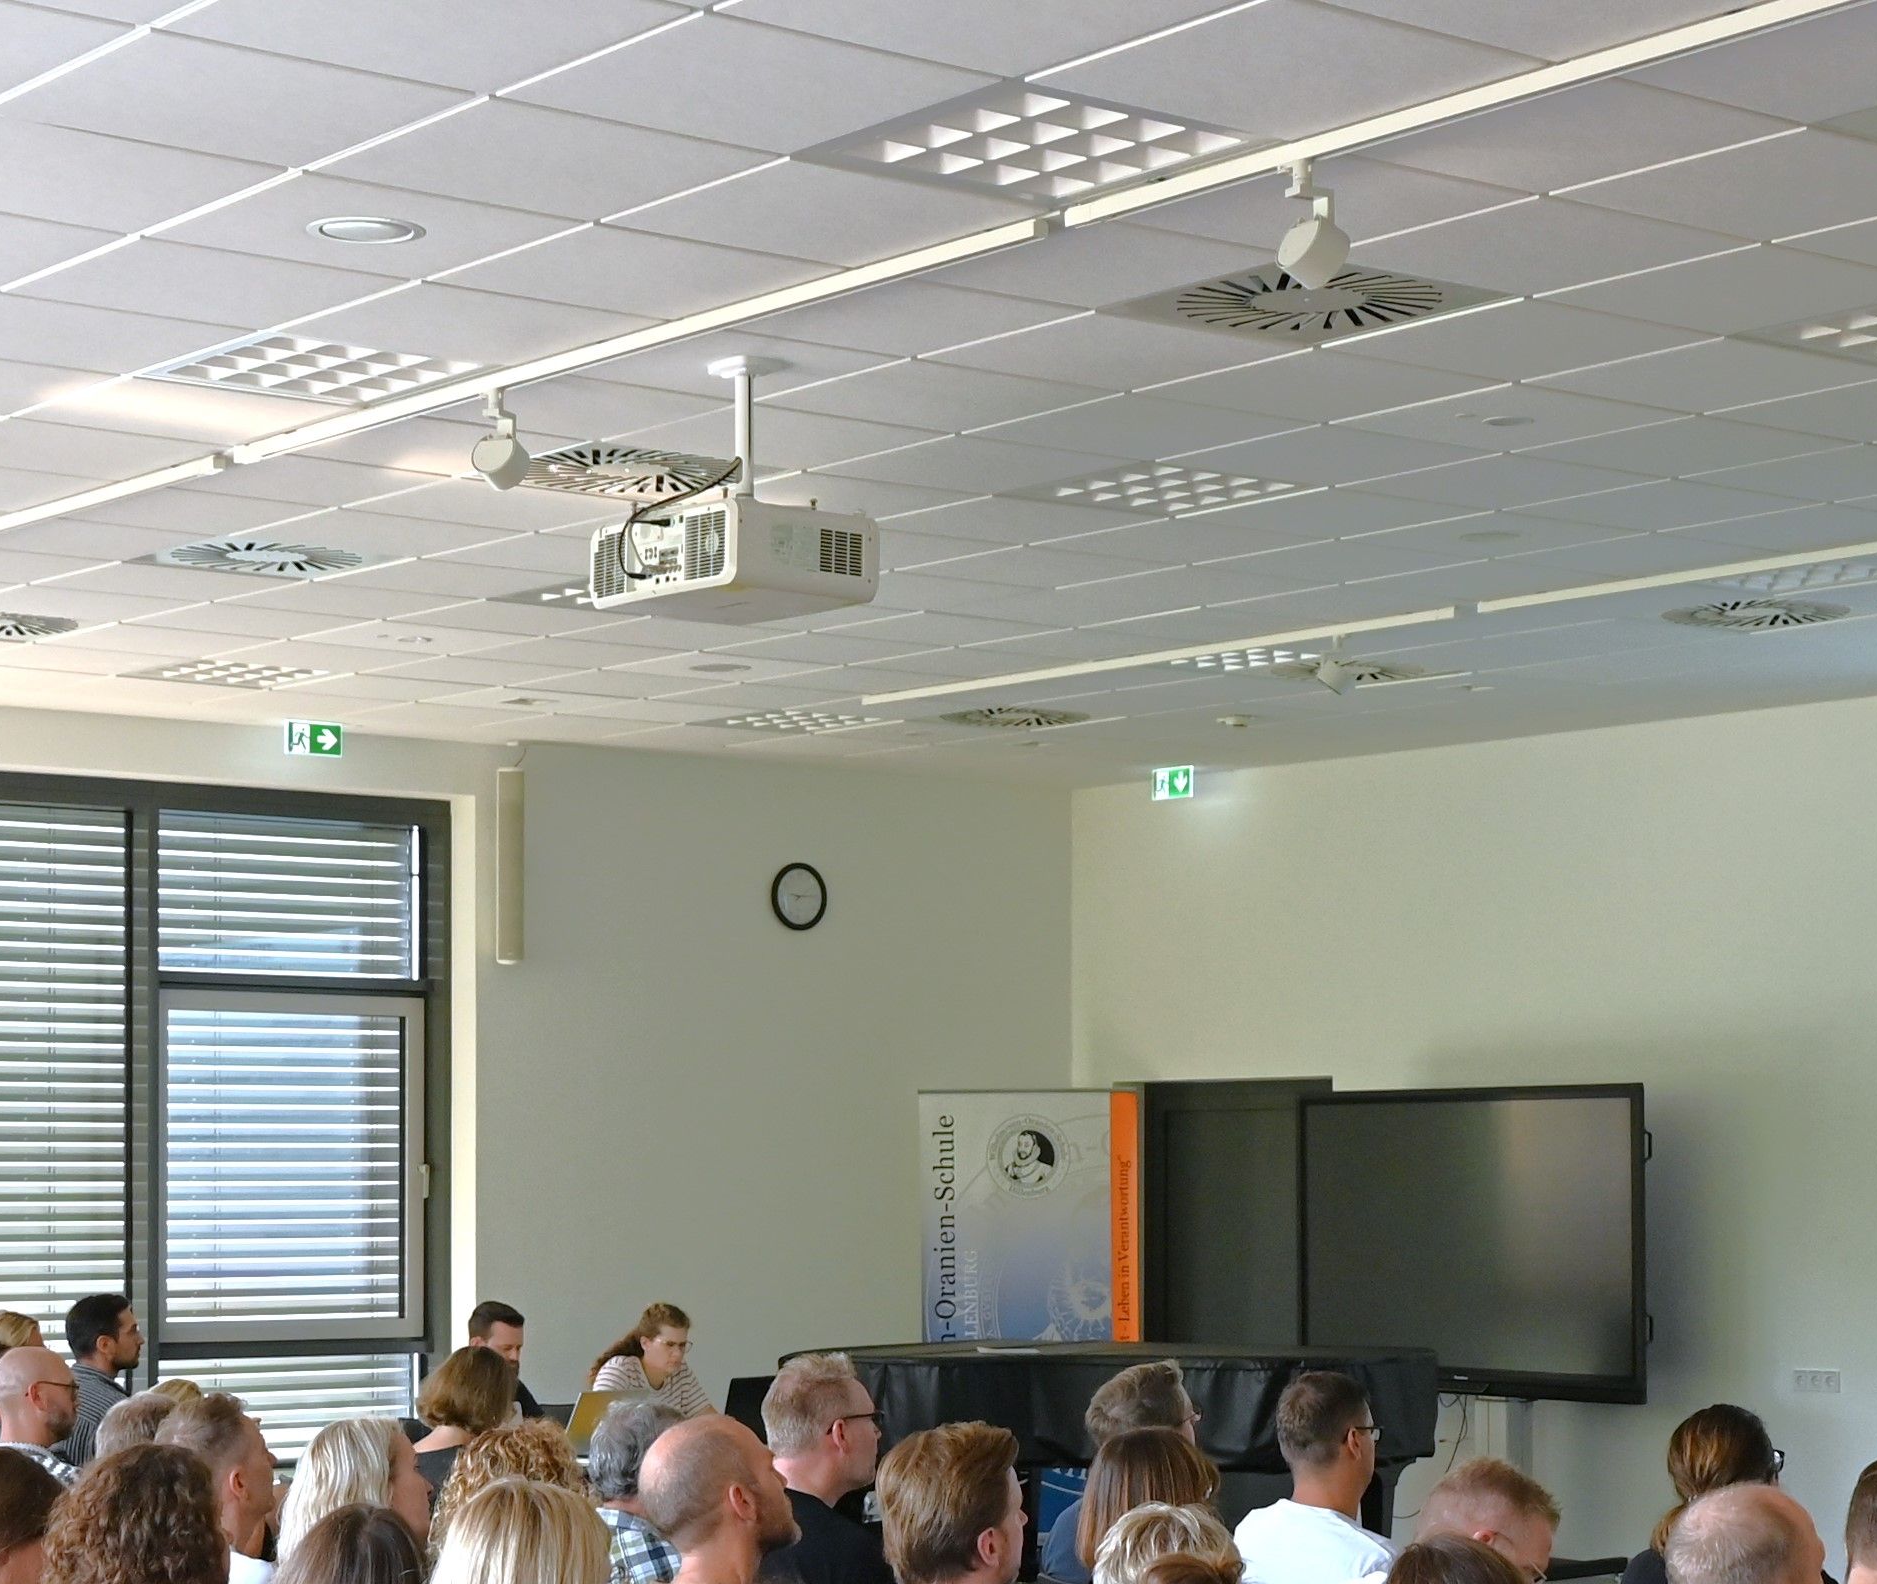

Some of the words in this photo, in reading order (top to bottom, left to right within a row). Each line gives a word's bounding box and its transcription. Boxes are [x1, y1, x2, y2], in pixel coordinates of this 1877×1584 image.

[933, 1115, 955, 1342] n-Oranien-Schule
[964, 1250, 978, 1340] LENBURG
[1118, 1282, 1130, 1322] Leben
[1119, 1265, 1130, 1278] in
